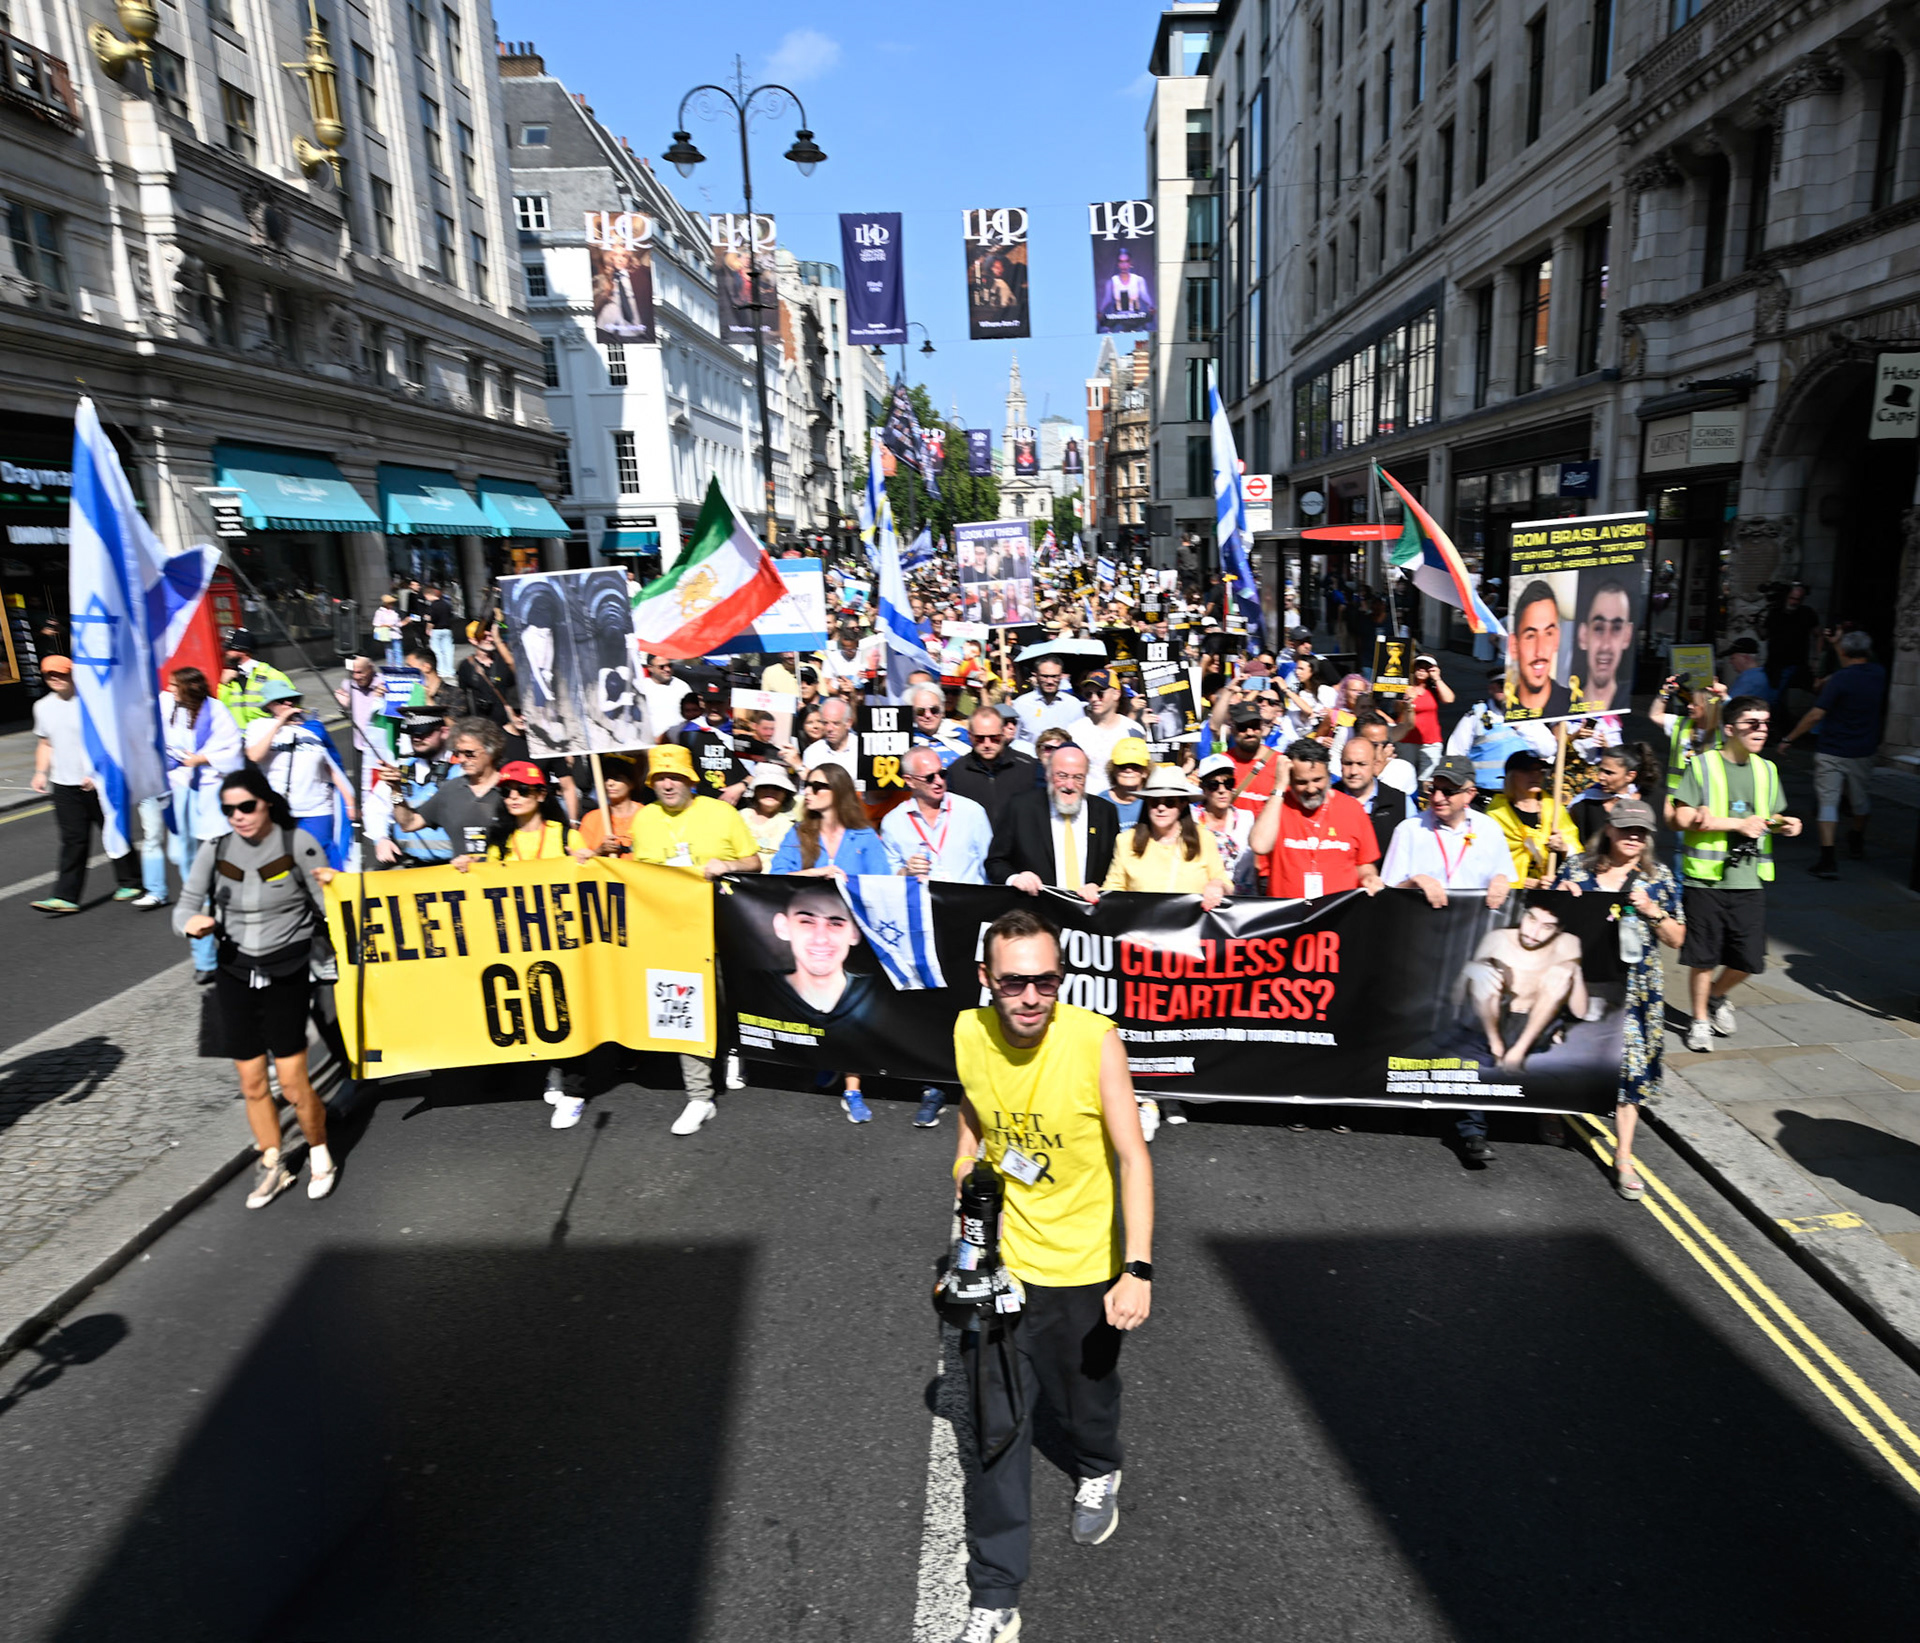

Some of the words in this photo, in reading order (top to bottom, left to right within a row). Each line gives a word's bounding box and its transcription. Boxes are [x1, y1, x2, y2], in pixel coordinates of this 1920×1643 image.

[1883, 365, 1920, 380] Hats
[1876, 407, 1917, 425] Caps
[1697, 428, 1735, 438] CARDS
[1513, 532, 1547, 547] ROM
[1550, 523, 1646, 544] BRASLAVSKI
[871, 707, 899, 731] LET
[704, 744, 727, 757] LET
[861, 731, 910, 756] THEM
[482, 880, 629, 954] THEM
[1120, 937, 1289, 979] CLUELESS
[1292, 930, 1340, 973] OR
[481, 960, 571, 1047] GO
[660, 998, 690, 1013] THE
[1058, 973, 1117, 1015] YOU
[1123, 977, 1336, 1022] HEARTLESS?
[656, 1014, 693, 1028] HATE
[993, 1111, 1044, 1132] LET
[989, 1128, 1065, 1149] THEM
